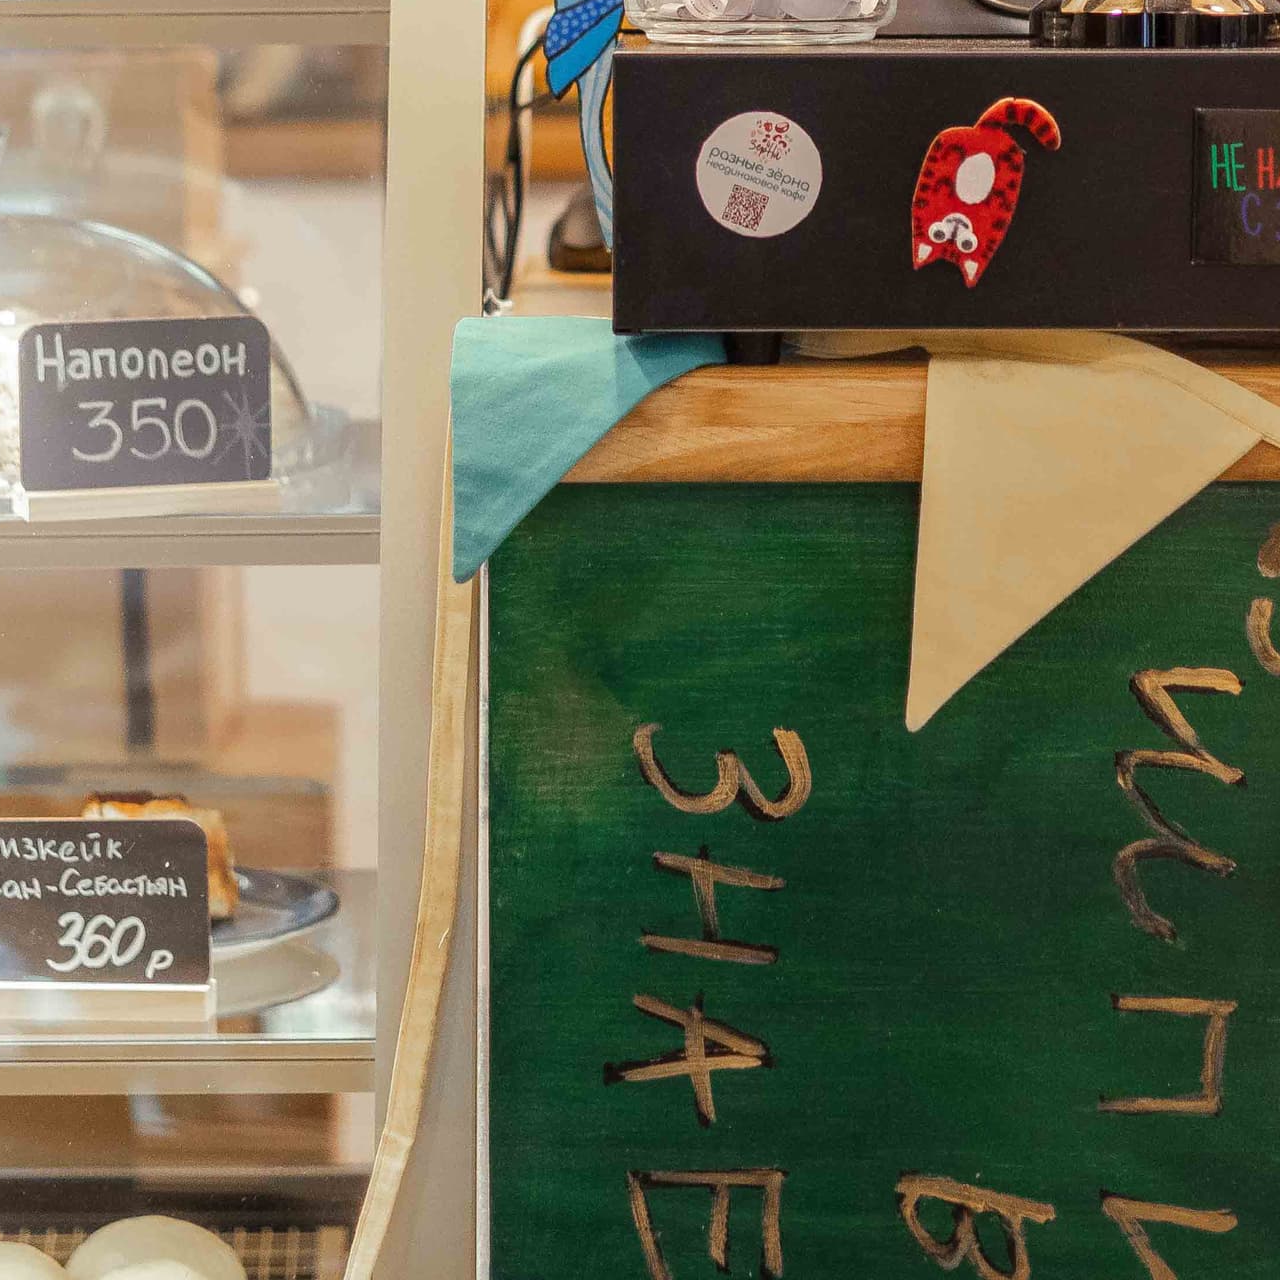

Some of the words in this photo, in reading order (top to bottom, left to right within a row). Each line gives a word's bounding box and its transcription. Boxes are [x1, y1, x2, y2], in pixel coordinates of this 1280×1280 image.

[708, 147, 764, 176] разные
[766, 168, 810, 193] зёрна
[1211, 141, 1247, 192] НЕ
[1241, 192, 1262, 236] С
[35, 332, 246, 387] Наполеон
[72, 397, 217, 462] 350
